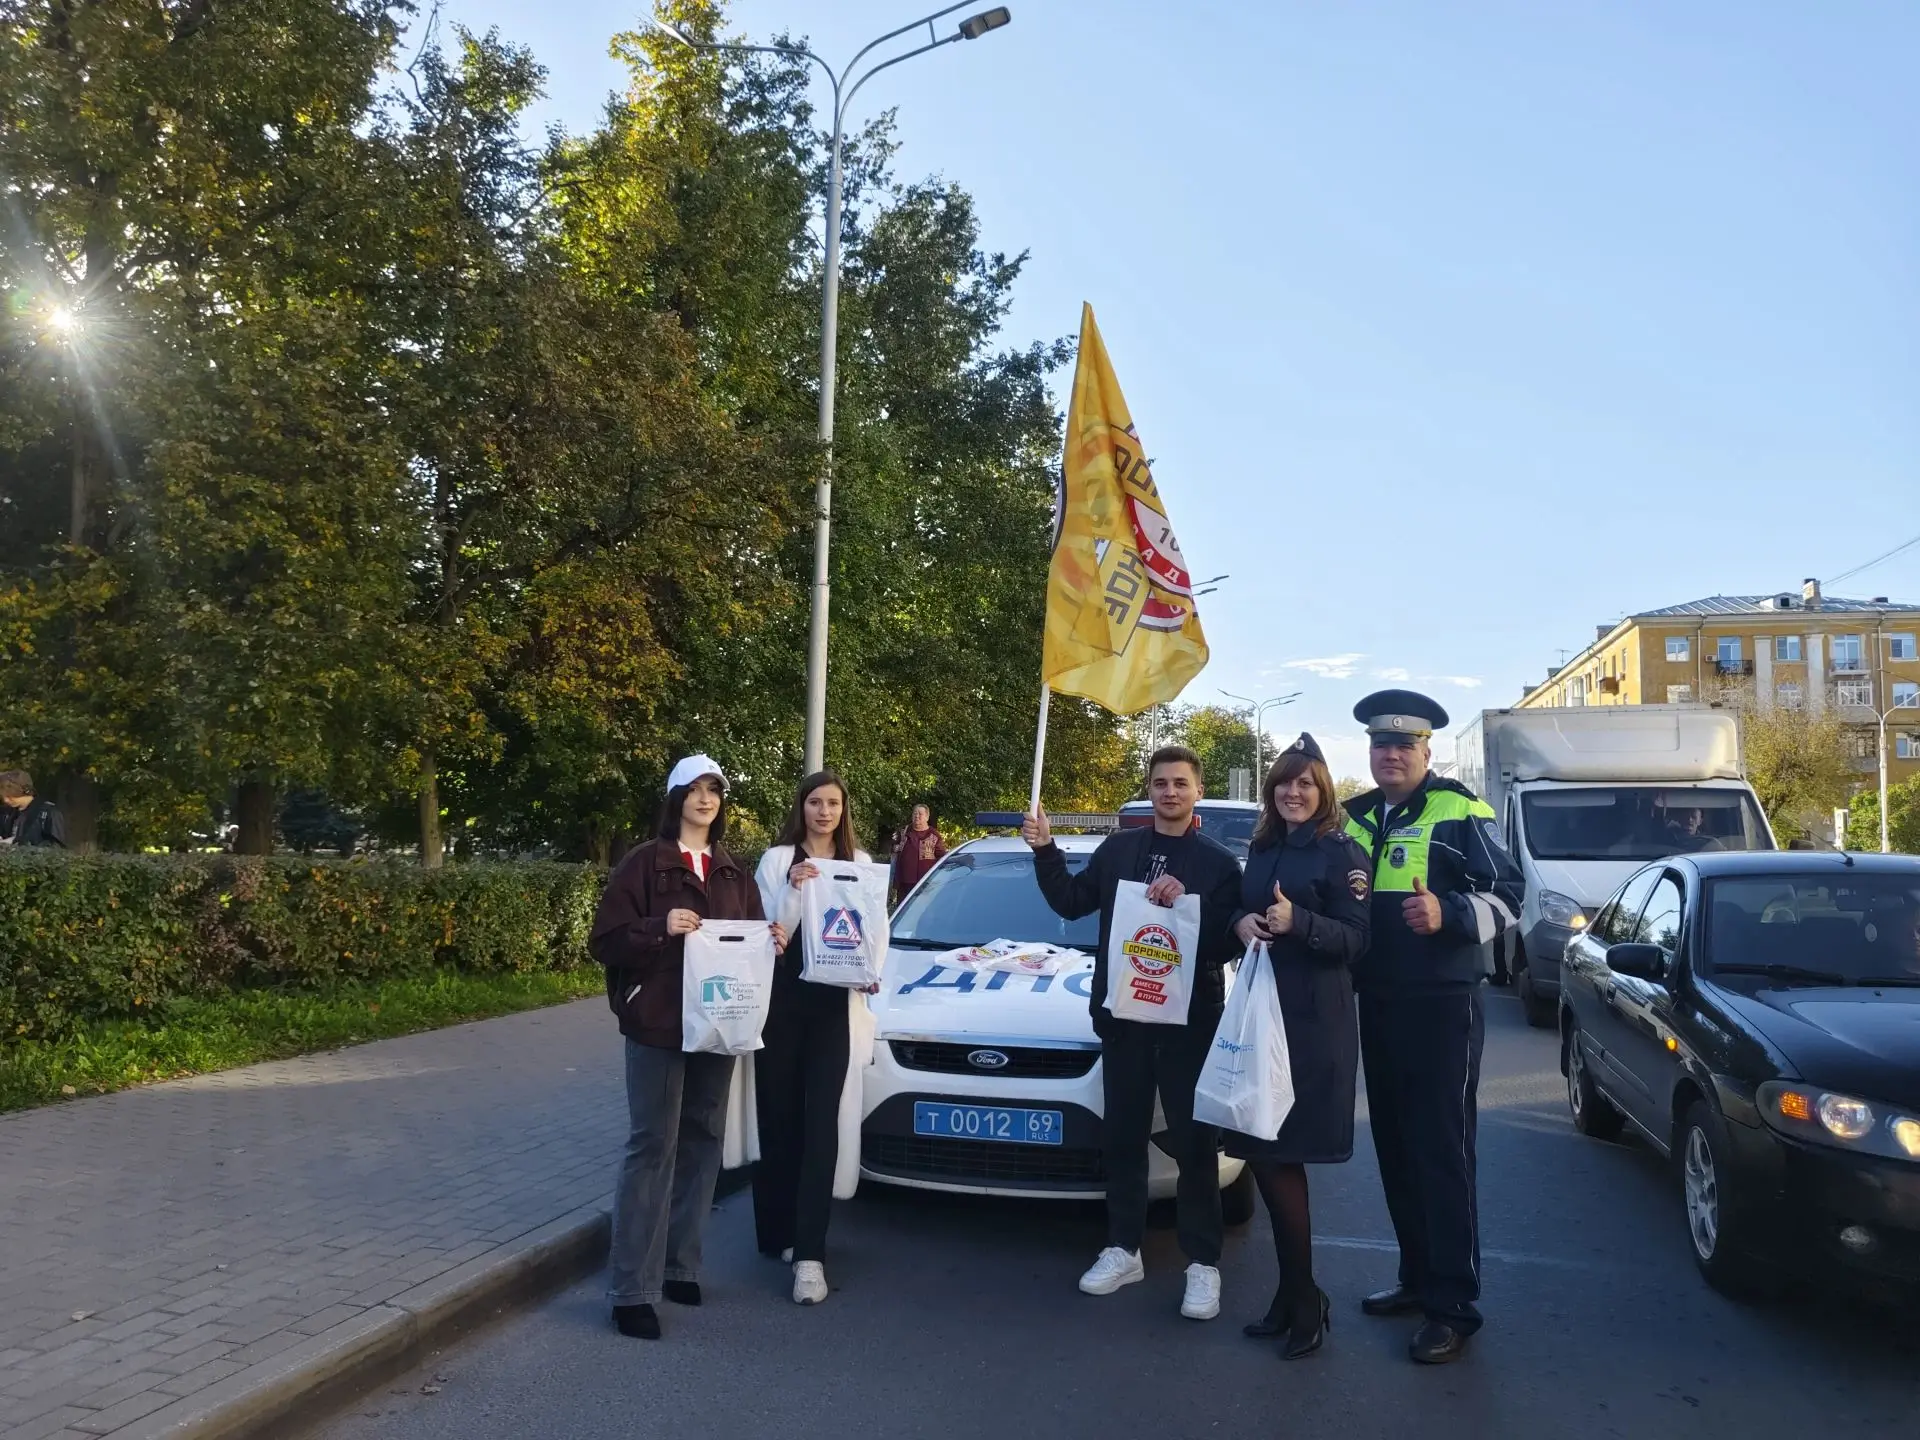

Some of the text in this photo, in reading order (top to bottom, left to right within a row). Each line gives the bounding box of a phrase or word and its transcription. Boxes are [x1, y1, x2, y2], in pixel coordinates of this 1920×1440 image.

[1128, 944, 1180, 963] ДОРОЖНОЕ
[1134, 980, 1160, 990] ВМЕСТЕ
[976, 1053, 998, 1065] Ford
[928, 1109, 1053, 1137] Т 0012 69
[1031, 1132, 1050, 1141] RUS
